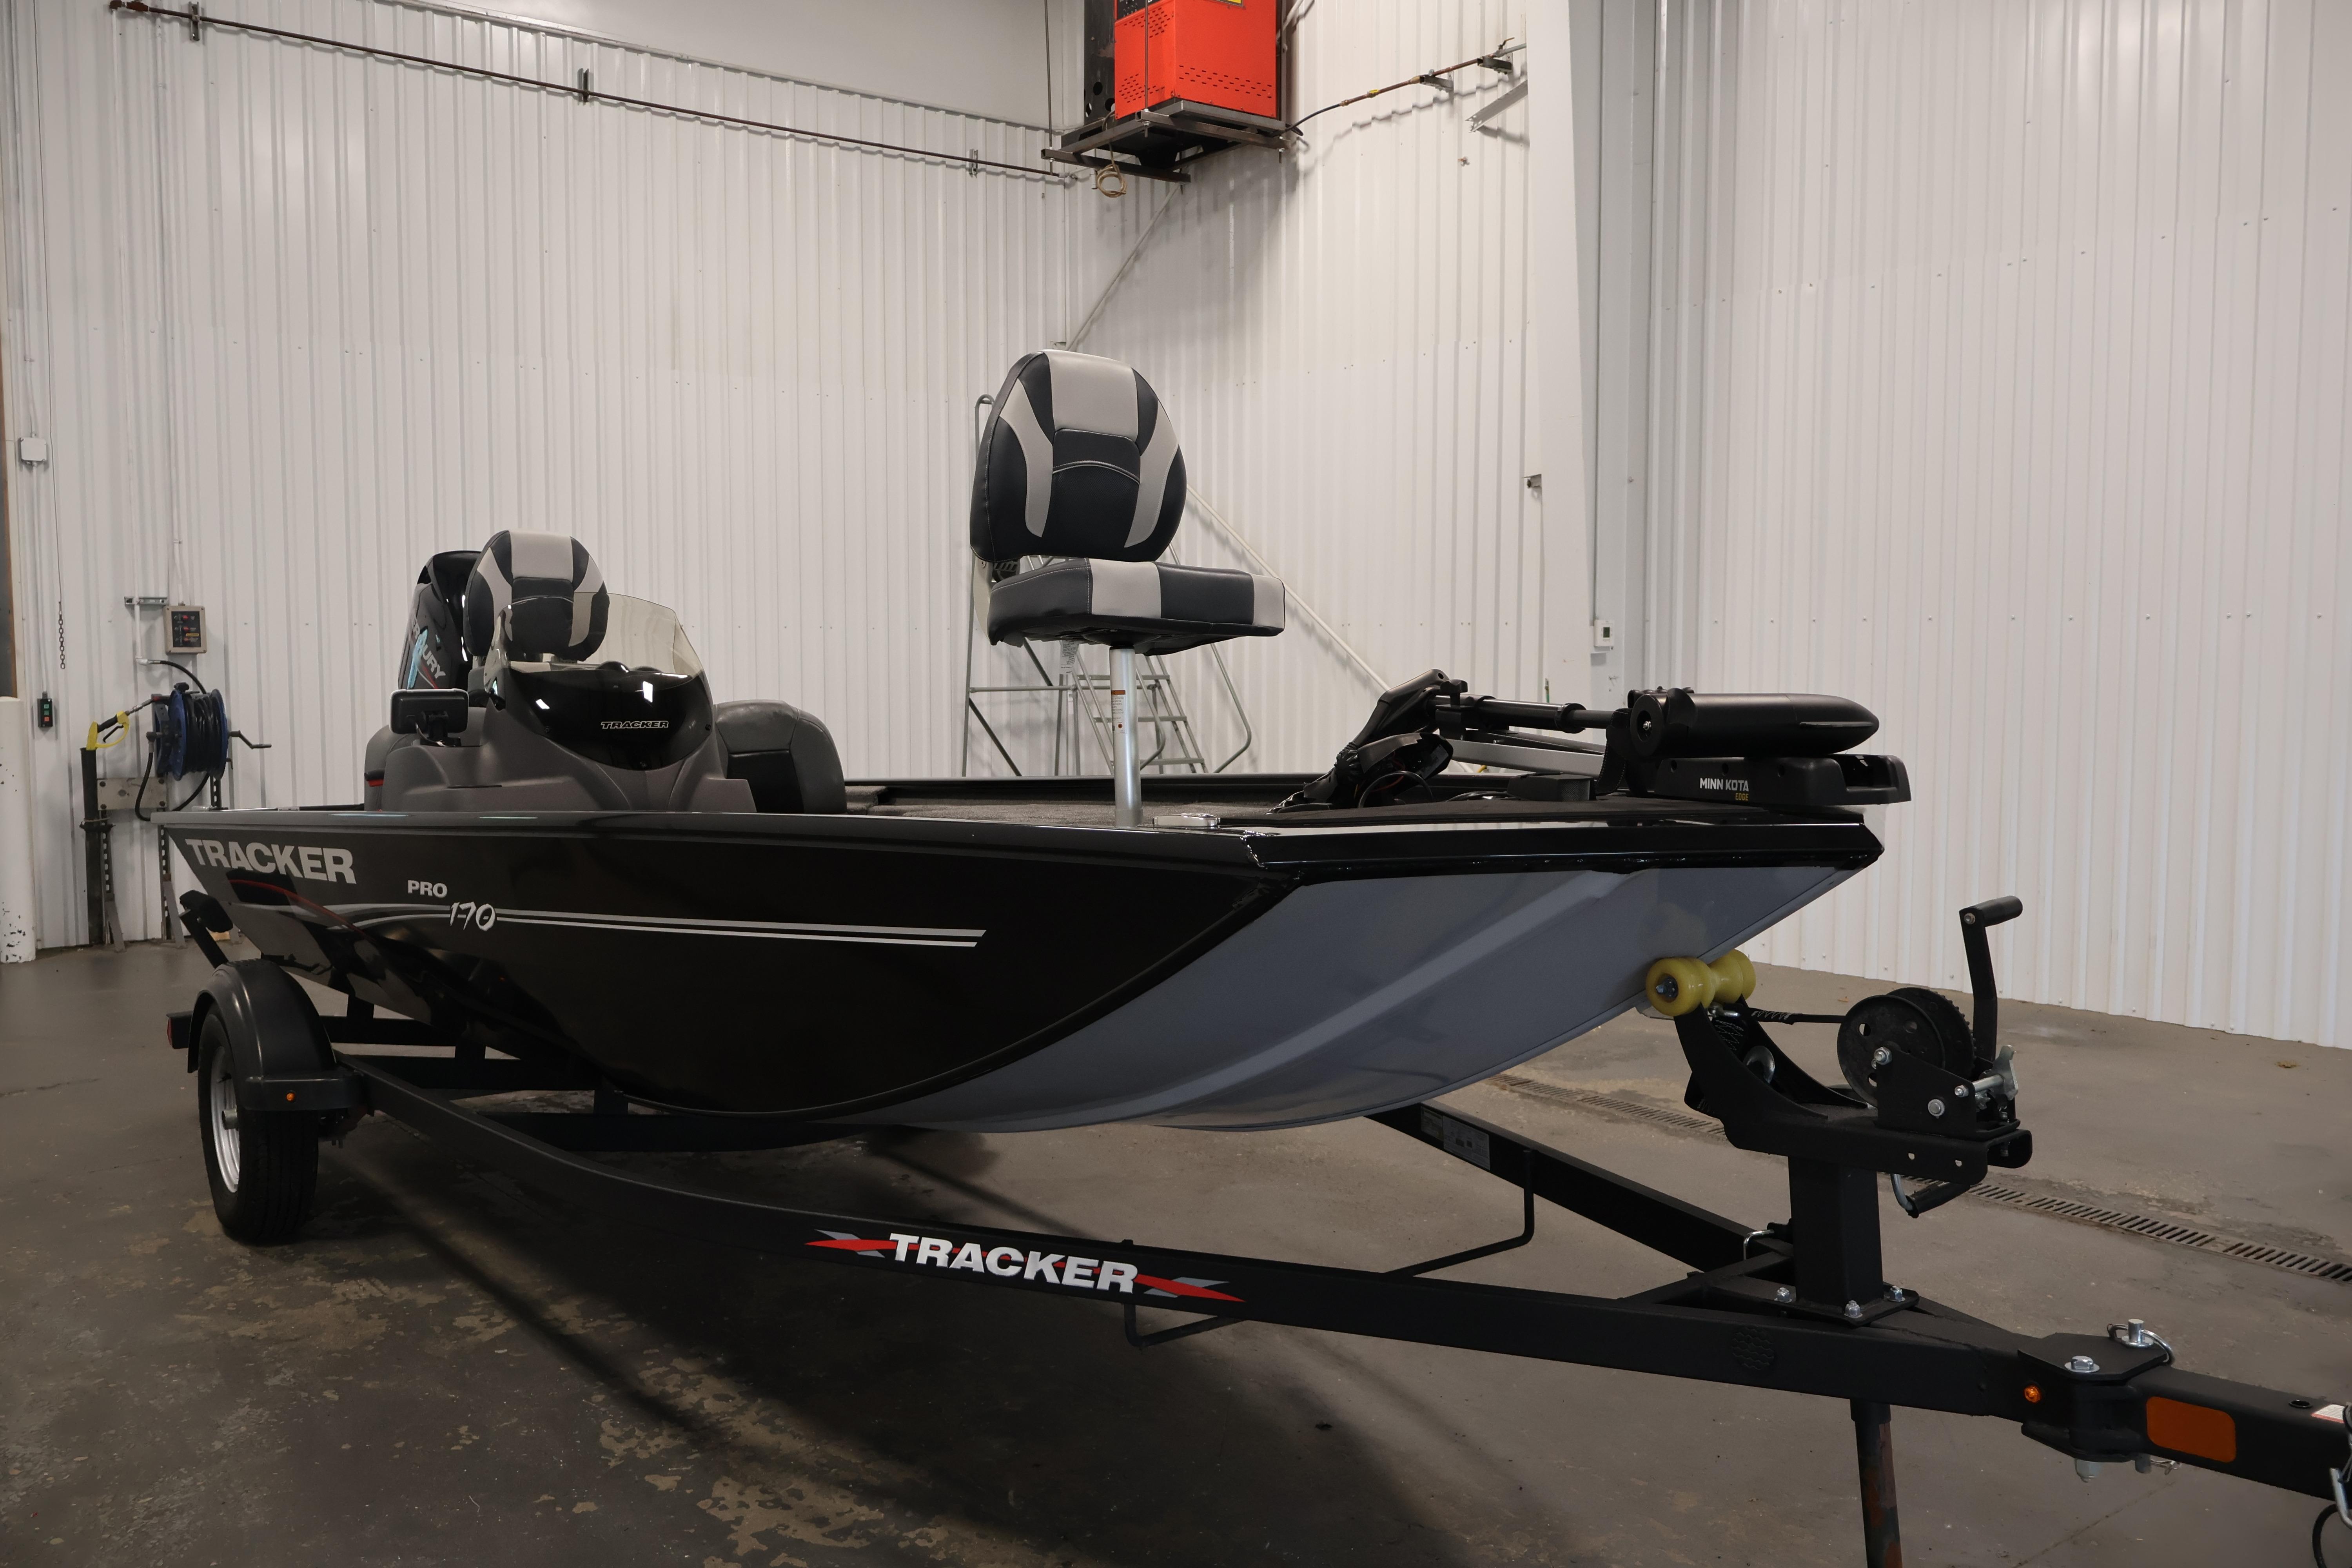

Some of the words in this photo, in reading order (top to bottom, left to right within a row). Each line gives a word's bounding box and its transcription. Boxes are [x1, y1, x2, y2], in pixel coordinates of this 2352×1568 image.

[601, 720, 669, 729] TRACKER
[1700, 778, 1723, 790] MINN
[1726, 779, 1749, 791] KOTA
[1735, 793, 1749, 801] EDGE
[185, 839, 356, 884] TRACKER
[408, 880, 448, 898] PRO
[450, 902, 495, 931] 170
[889, 1232, 1138, 1294] TRACKER
